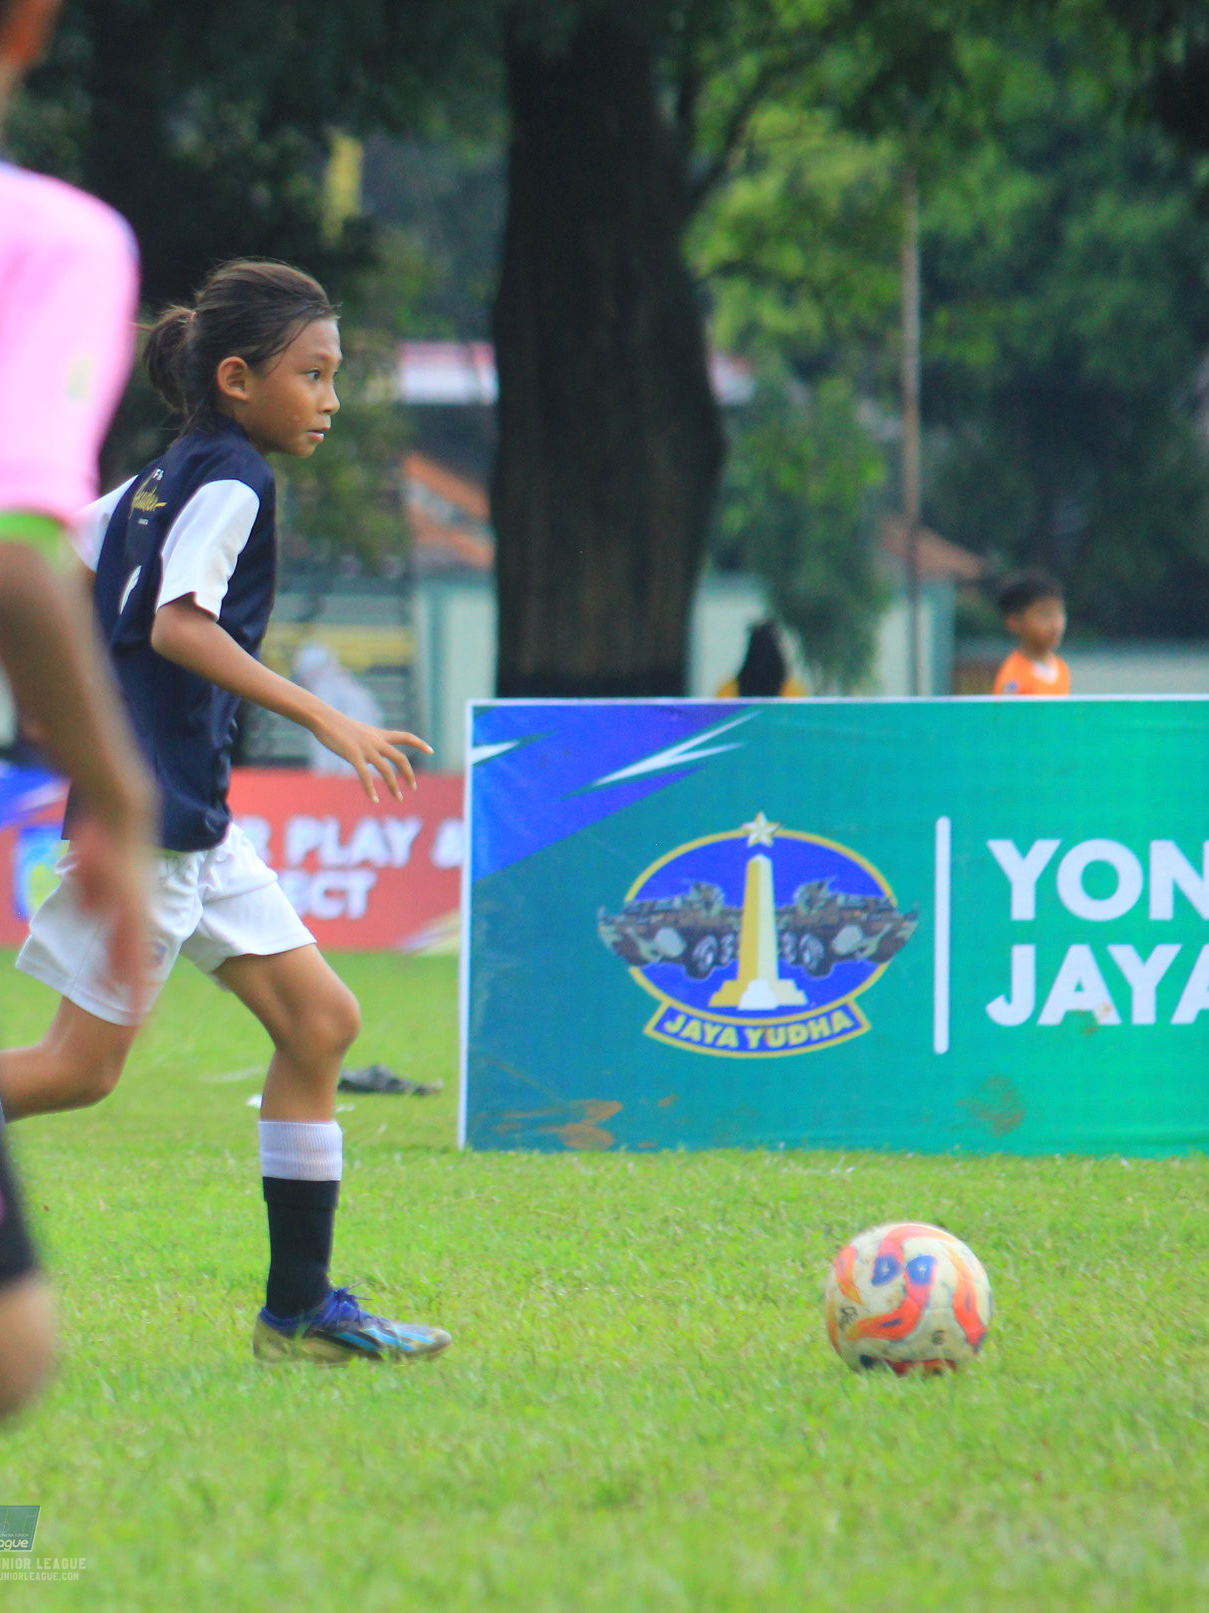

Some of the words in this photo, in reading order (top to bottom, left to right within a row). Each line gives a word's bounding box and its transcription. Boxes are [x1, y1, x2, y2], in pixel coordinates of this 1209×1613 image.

[286, 815, 423, 868] PLAY
[986, 838, 1209, 922] YON
[663, 1014, 739, 1049] JAYA
[744, 1009, 855, 1049] YUDHA
